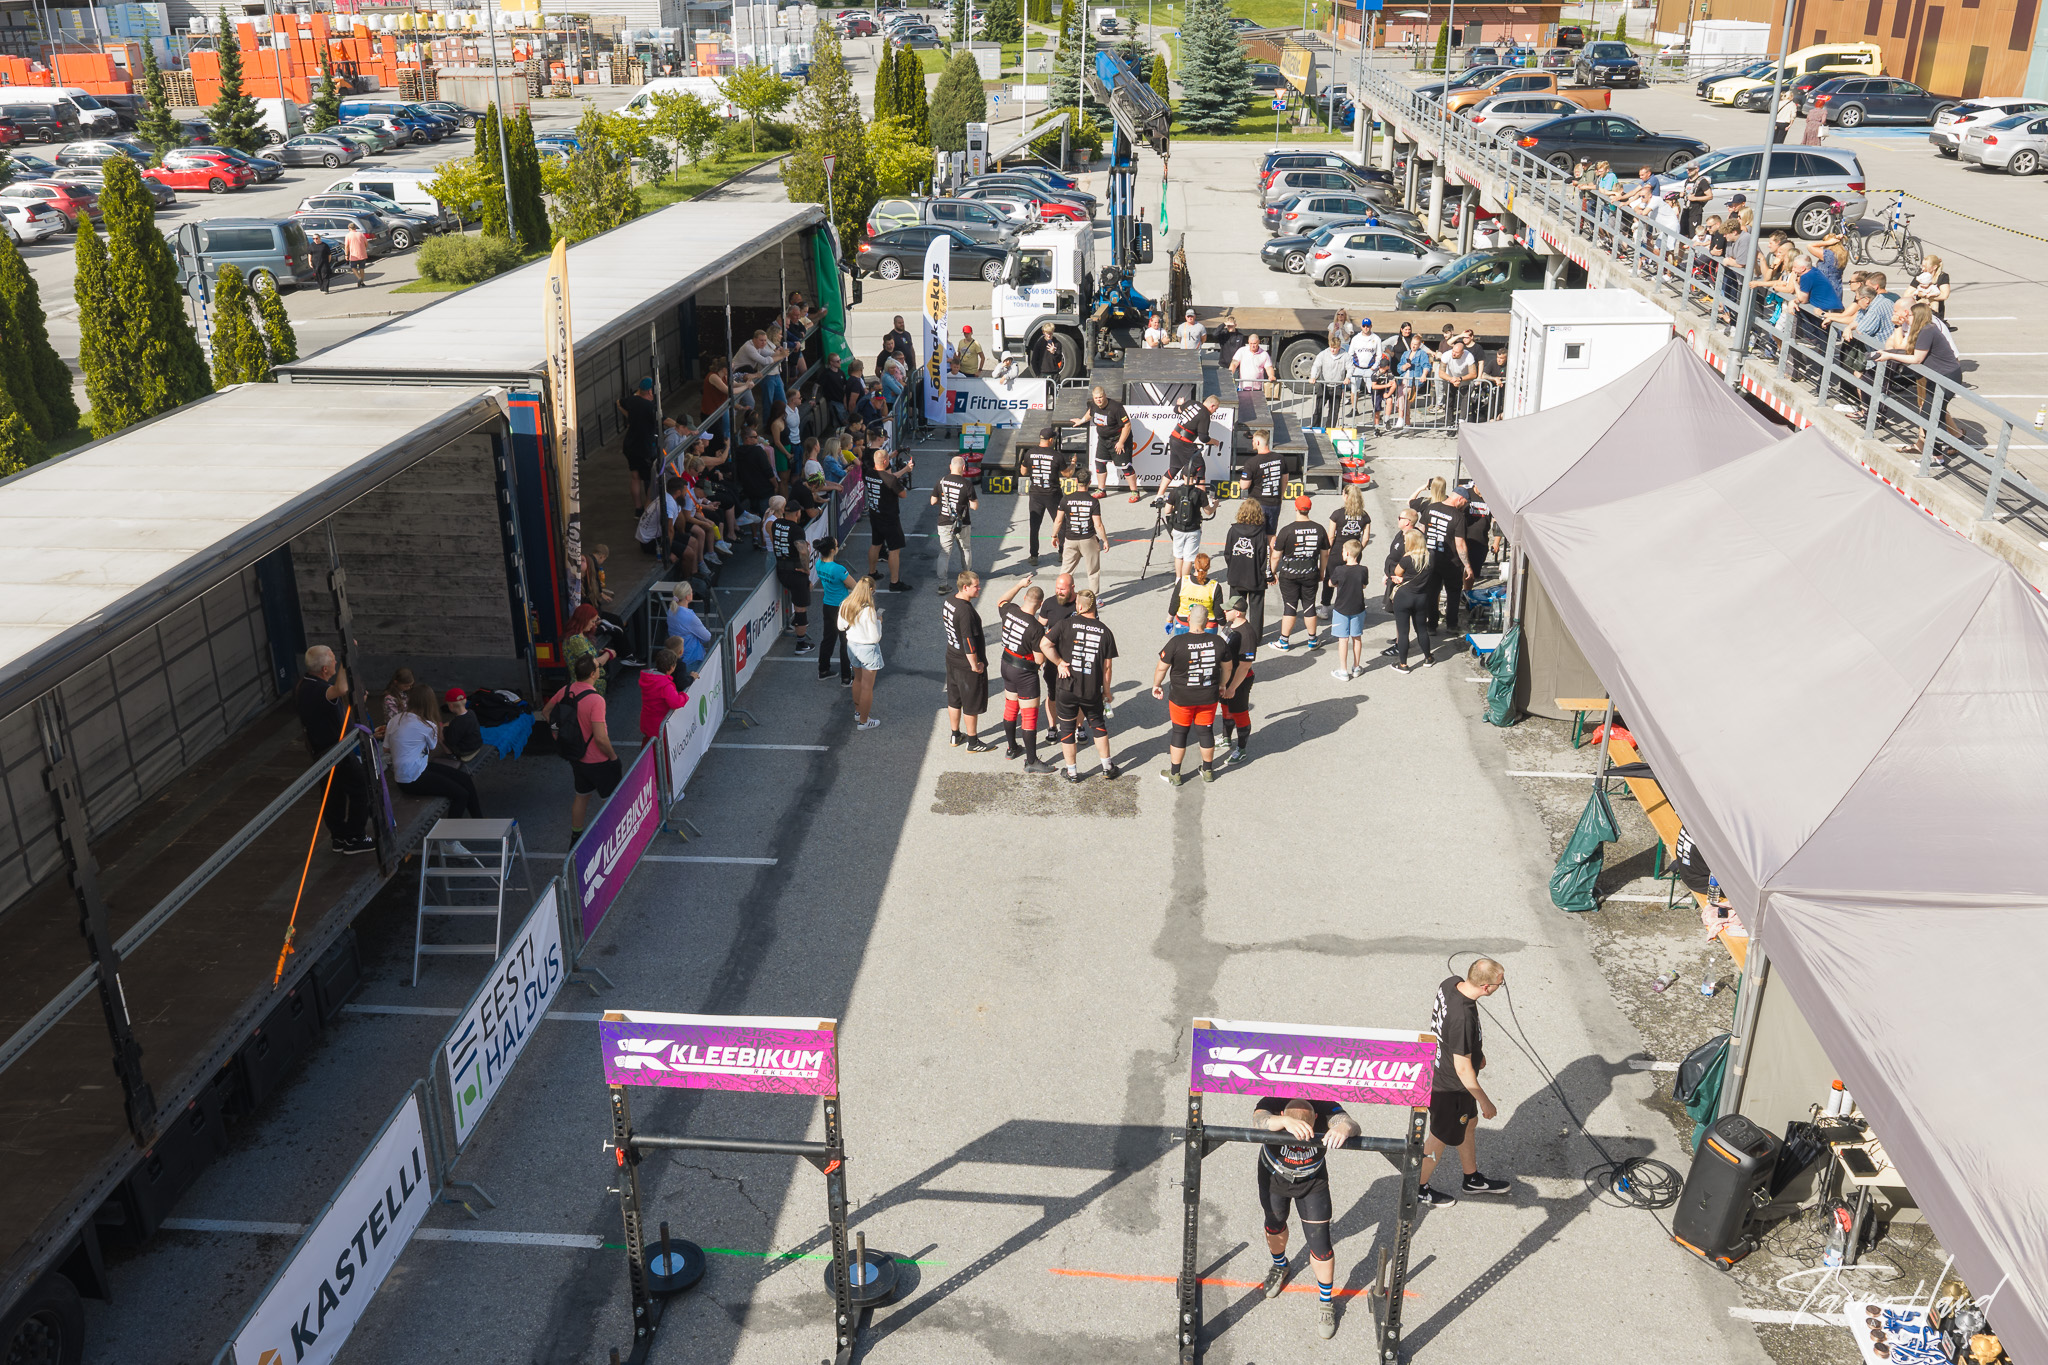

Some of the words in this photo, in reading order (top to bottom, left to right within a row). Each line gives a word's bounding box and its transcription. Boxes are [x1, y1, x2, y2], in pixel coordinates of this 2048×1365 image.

[930, 262, 940, 403] Lõunakeskus
[1129, 411, 1149, 419] valik
[989, 477, 1013, 494] 150
[1217, 481, 1240, 498] 150
[1086, 625, 1104, 634] OZOLS
[1187, 641, 1214, 650] ZUKULIS
[603, 776, 653, 869] KLEEBIKUM
[480, 933, 535, 1042] EESTI
[485, 942, 559, 1086] HALDUS
[669, 1044, 824, 1071] KLEEBIKUM
[1260, 1053, 1424, 1082] KLEEBIKUM
[753, 1068, 814, 1077] REKLAAM
[1346, 1079, 1409, 1089] REKLAAM
[291, 1146, 422, 1365] KASTELLI
